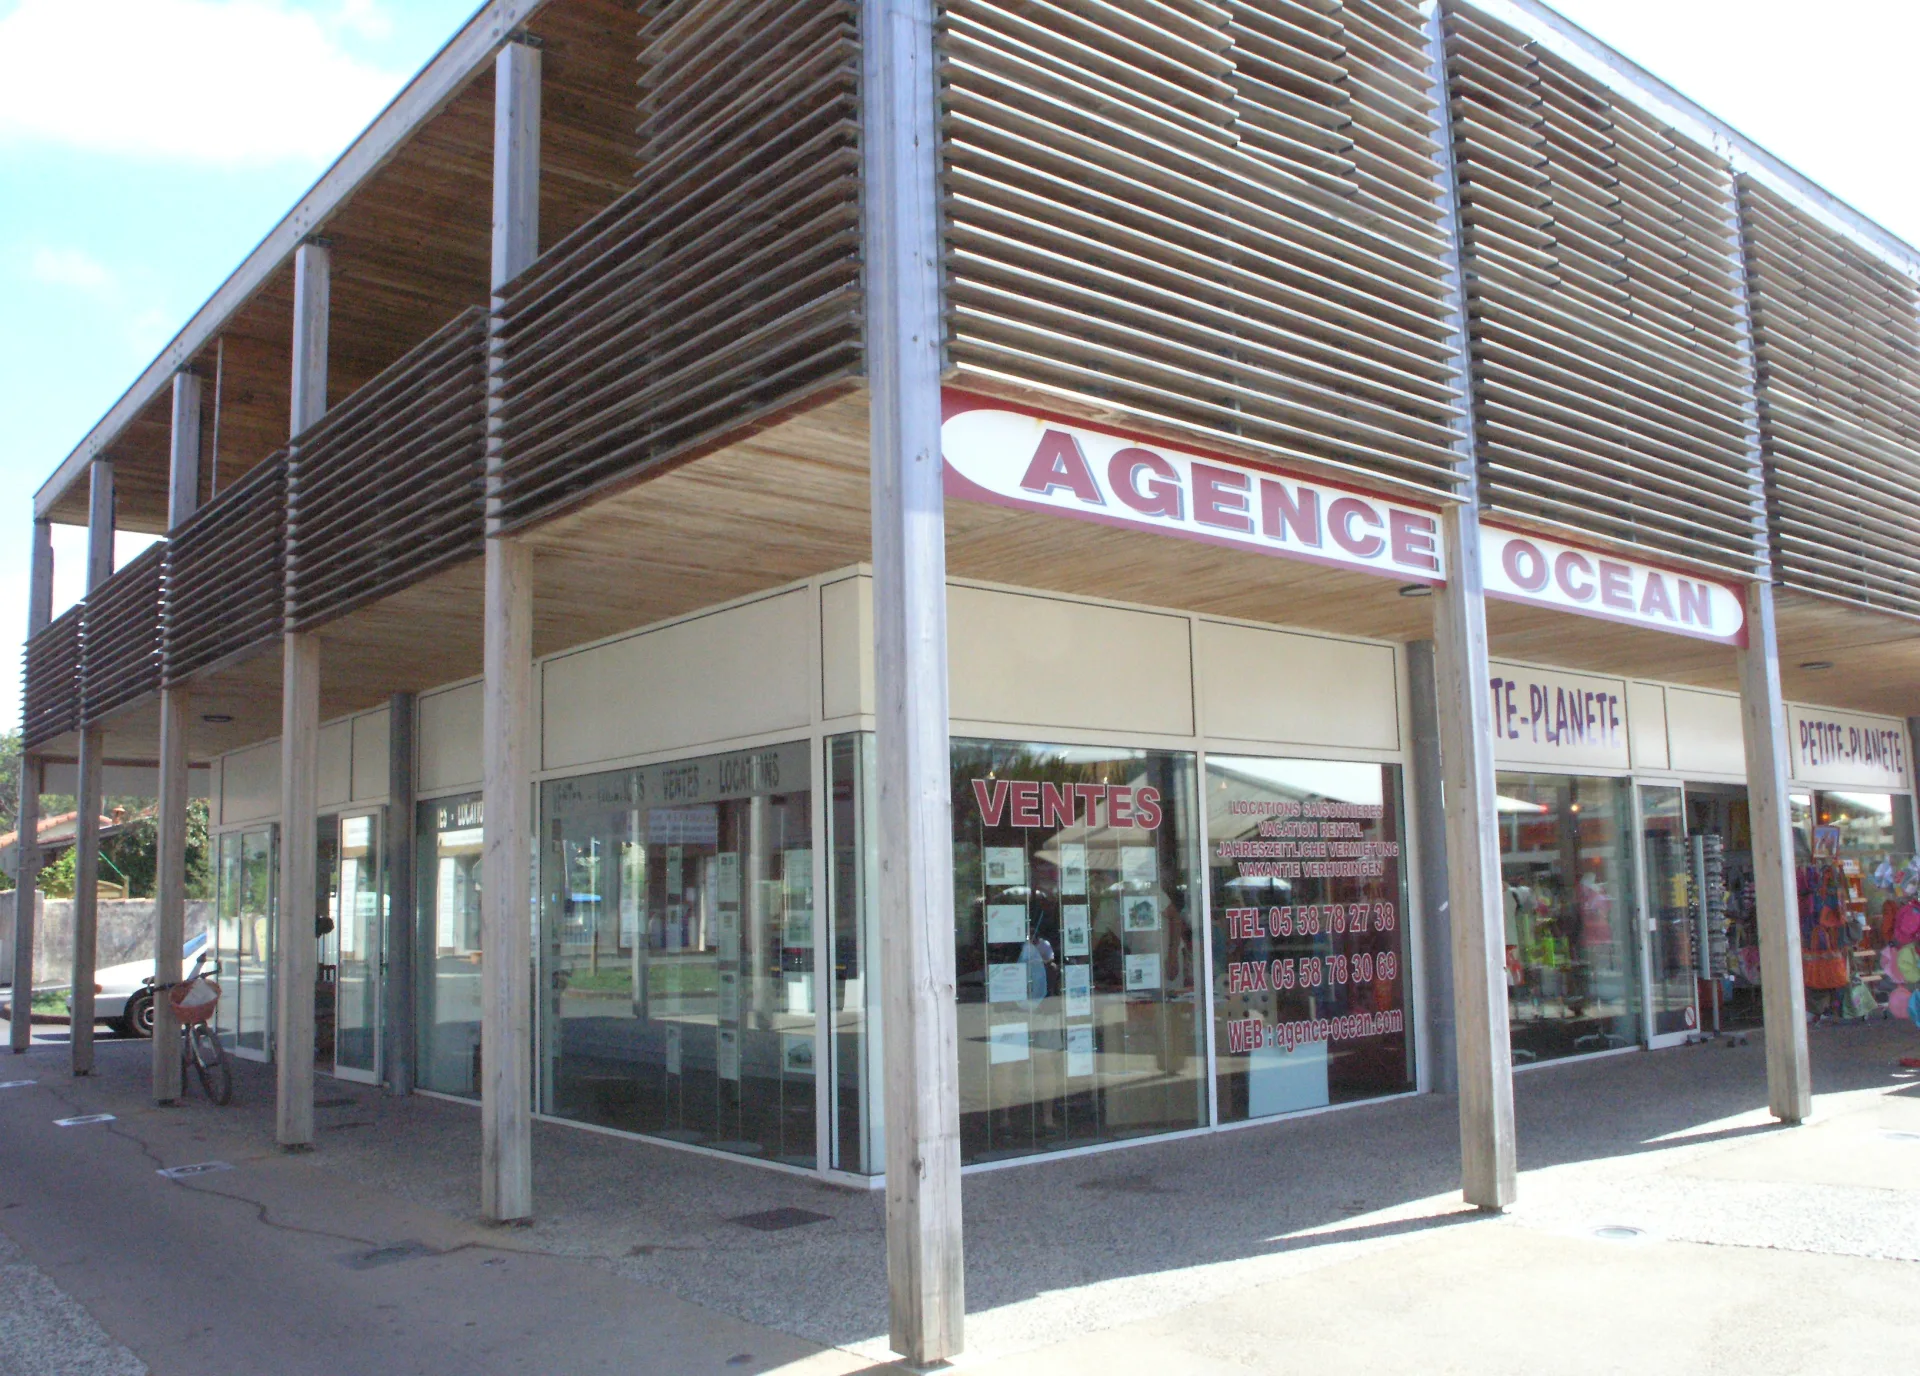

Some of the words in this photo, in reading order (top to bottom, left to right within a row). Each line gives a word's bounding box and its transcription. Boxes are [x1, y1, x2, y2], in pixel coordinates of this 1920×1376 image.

[1019, 429, 1439, 572] AGENCE
[1501, 539, 1712, 628] OCEAN
[1799, 719, 1903, 773] PETITE-PLANETE
[971, 778, 1162, 830] VENTES
[1231, 800, 1300, 817] LOCATIONS
[1303, 802, 1383, 818] SAISONNIERES
[1217, 841, 1328, 857] JAHRESZEITLICHE
[1328, 842, 1400, 857] VERMIETUNG
[1258, 821, 1319, 838] VACATION
[1320, 822, 1363, 838] RENTAL
[1238, 861, 1300, 877] VAKANTIE
[1226, 908, 1265, 939] TEL
[1269, 906, 1292, 937] 05
[1297, 905, 1319, 936] 58
[1323, 904, 1345, 933] 78
[1349, 903, 1370, 932] 27
[1374, 902, 1394, 931] 38
[1229, 961, 1267, 993] FAX
[1272, 959, 1295, 990] 05
[1299, 957, 1321, 987] 58
[1326, 955, 1348, 984] 78
[1352, 953, 1372, 982] 30
[1376, 951, 1397, 980] 69
[1228, 1019, 1264, 1053] WEB
[1277, 1009, 1402, 1052] agence-ocean.com
